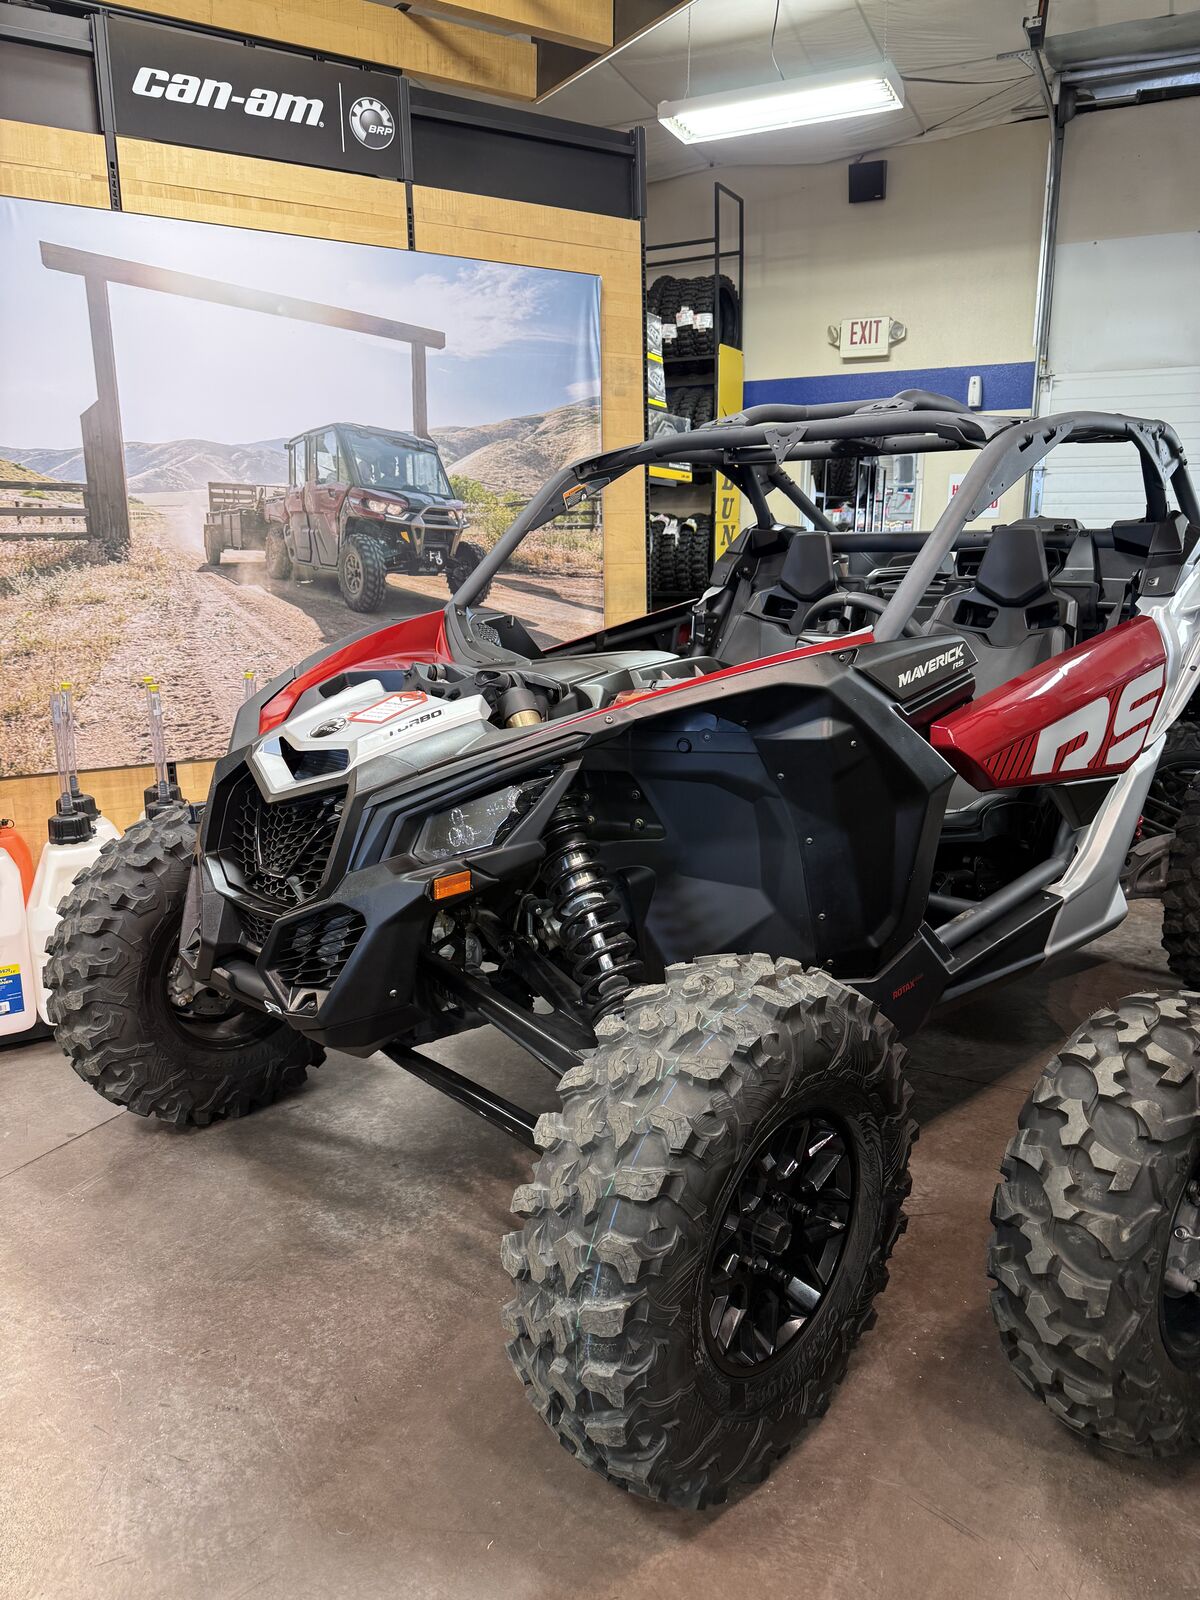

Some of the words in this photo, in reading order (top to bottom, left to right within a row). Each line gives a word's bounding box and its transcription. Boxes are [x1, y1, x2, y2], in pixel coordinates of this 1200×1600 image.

[132, 66, 324, 127] can-am
[368, 124, 393, 136] BRP
[850, 320, 882, 345] EXIT
[898, 643, 964, 688] MAVERICK
[952, 659, 964, 670] RS
[1031, 664, 1164, 775] RS
[892, 981, 915, 1000] ROTAX
